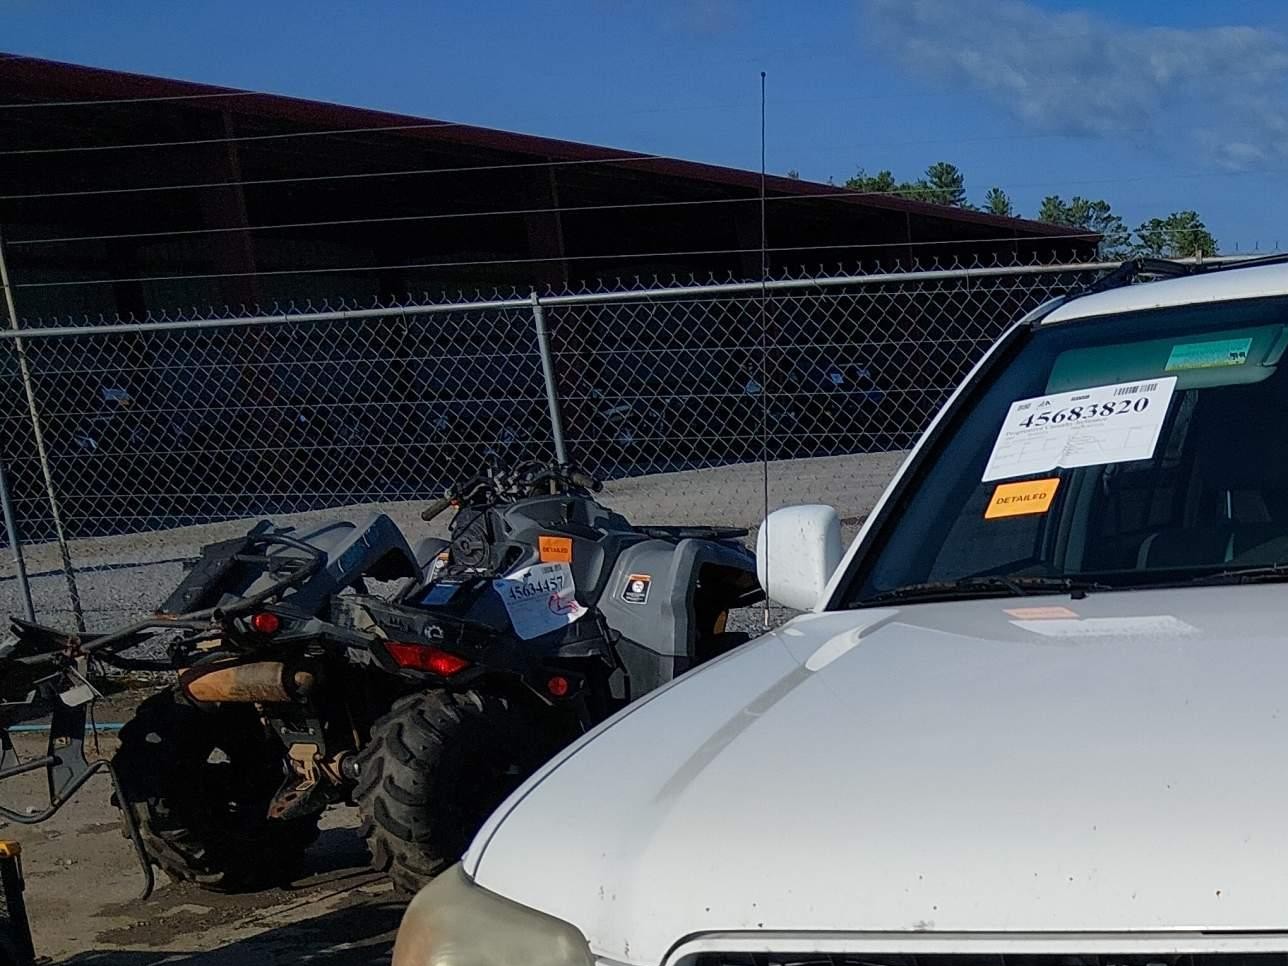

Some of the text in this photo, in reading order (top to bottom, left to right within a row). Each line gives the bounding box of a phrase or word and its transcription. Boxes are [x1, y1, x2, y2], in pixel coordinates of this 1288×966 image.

[1018, 397, 1150, 429] 45683820
[996, 492, 1047, 505] DETAILED
[509, 575, 563, 600] 45634457
